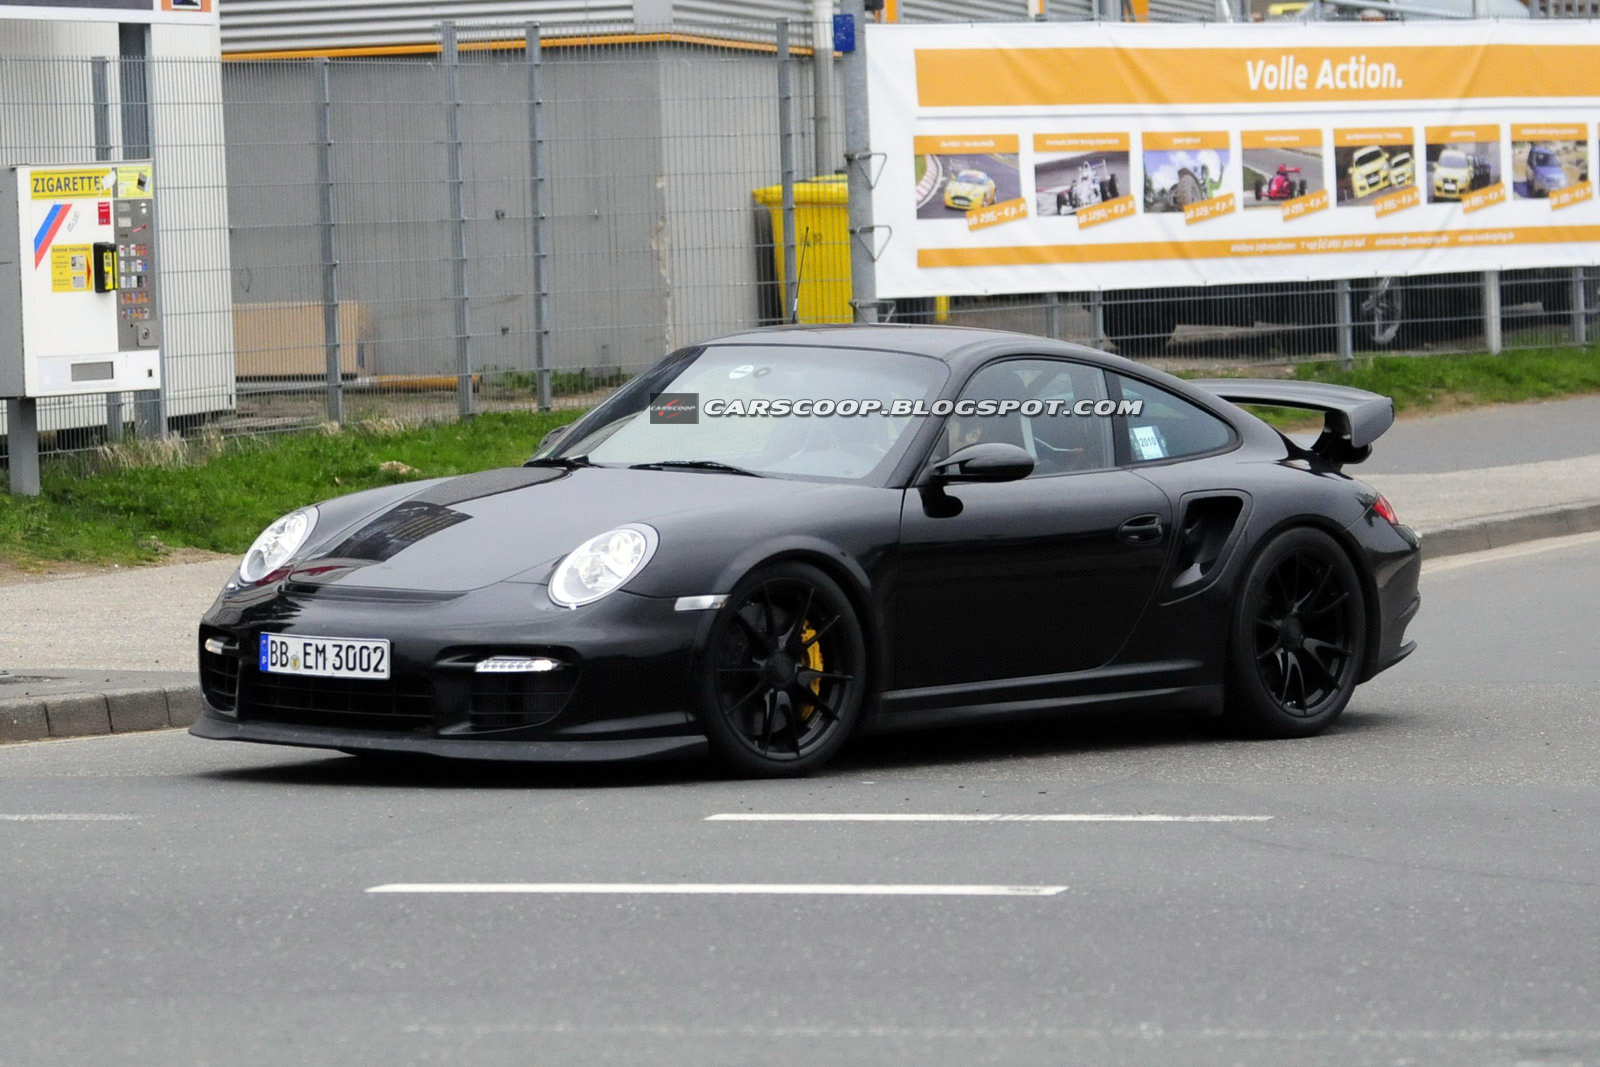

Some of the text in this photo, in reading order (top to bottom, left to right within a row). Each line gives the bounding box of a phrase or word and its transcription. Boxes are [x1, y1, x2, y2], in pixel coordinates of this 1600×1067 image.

[1246, 54, 1403, 91] Volle Action.
[1139, 436, 1157, 448] 2010
[270, 640, 385, 673] BB EM 3002
